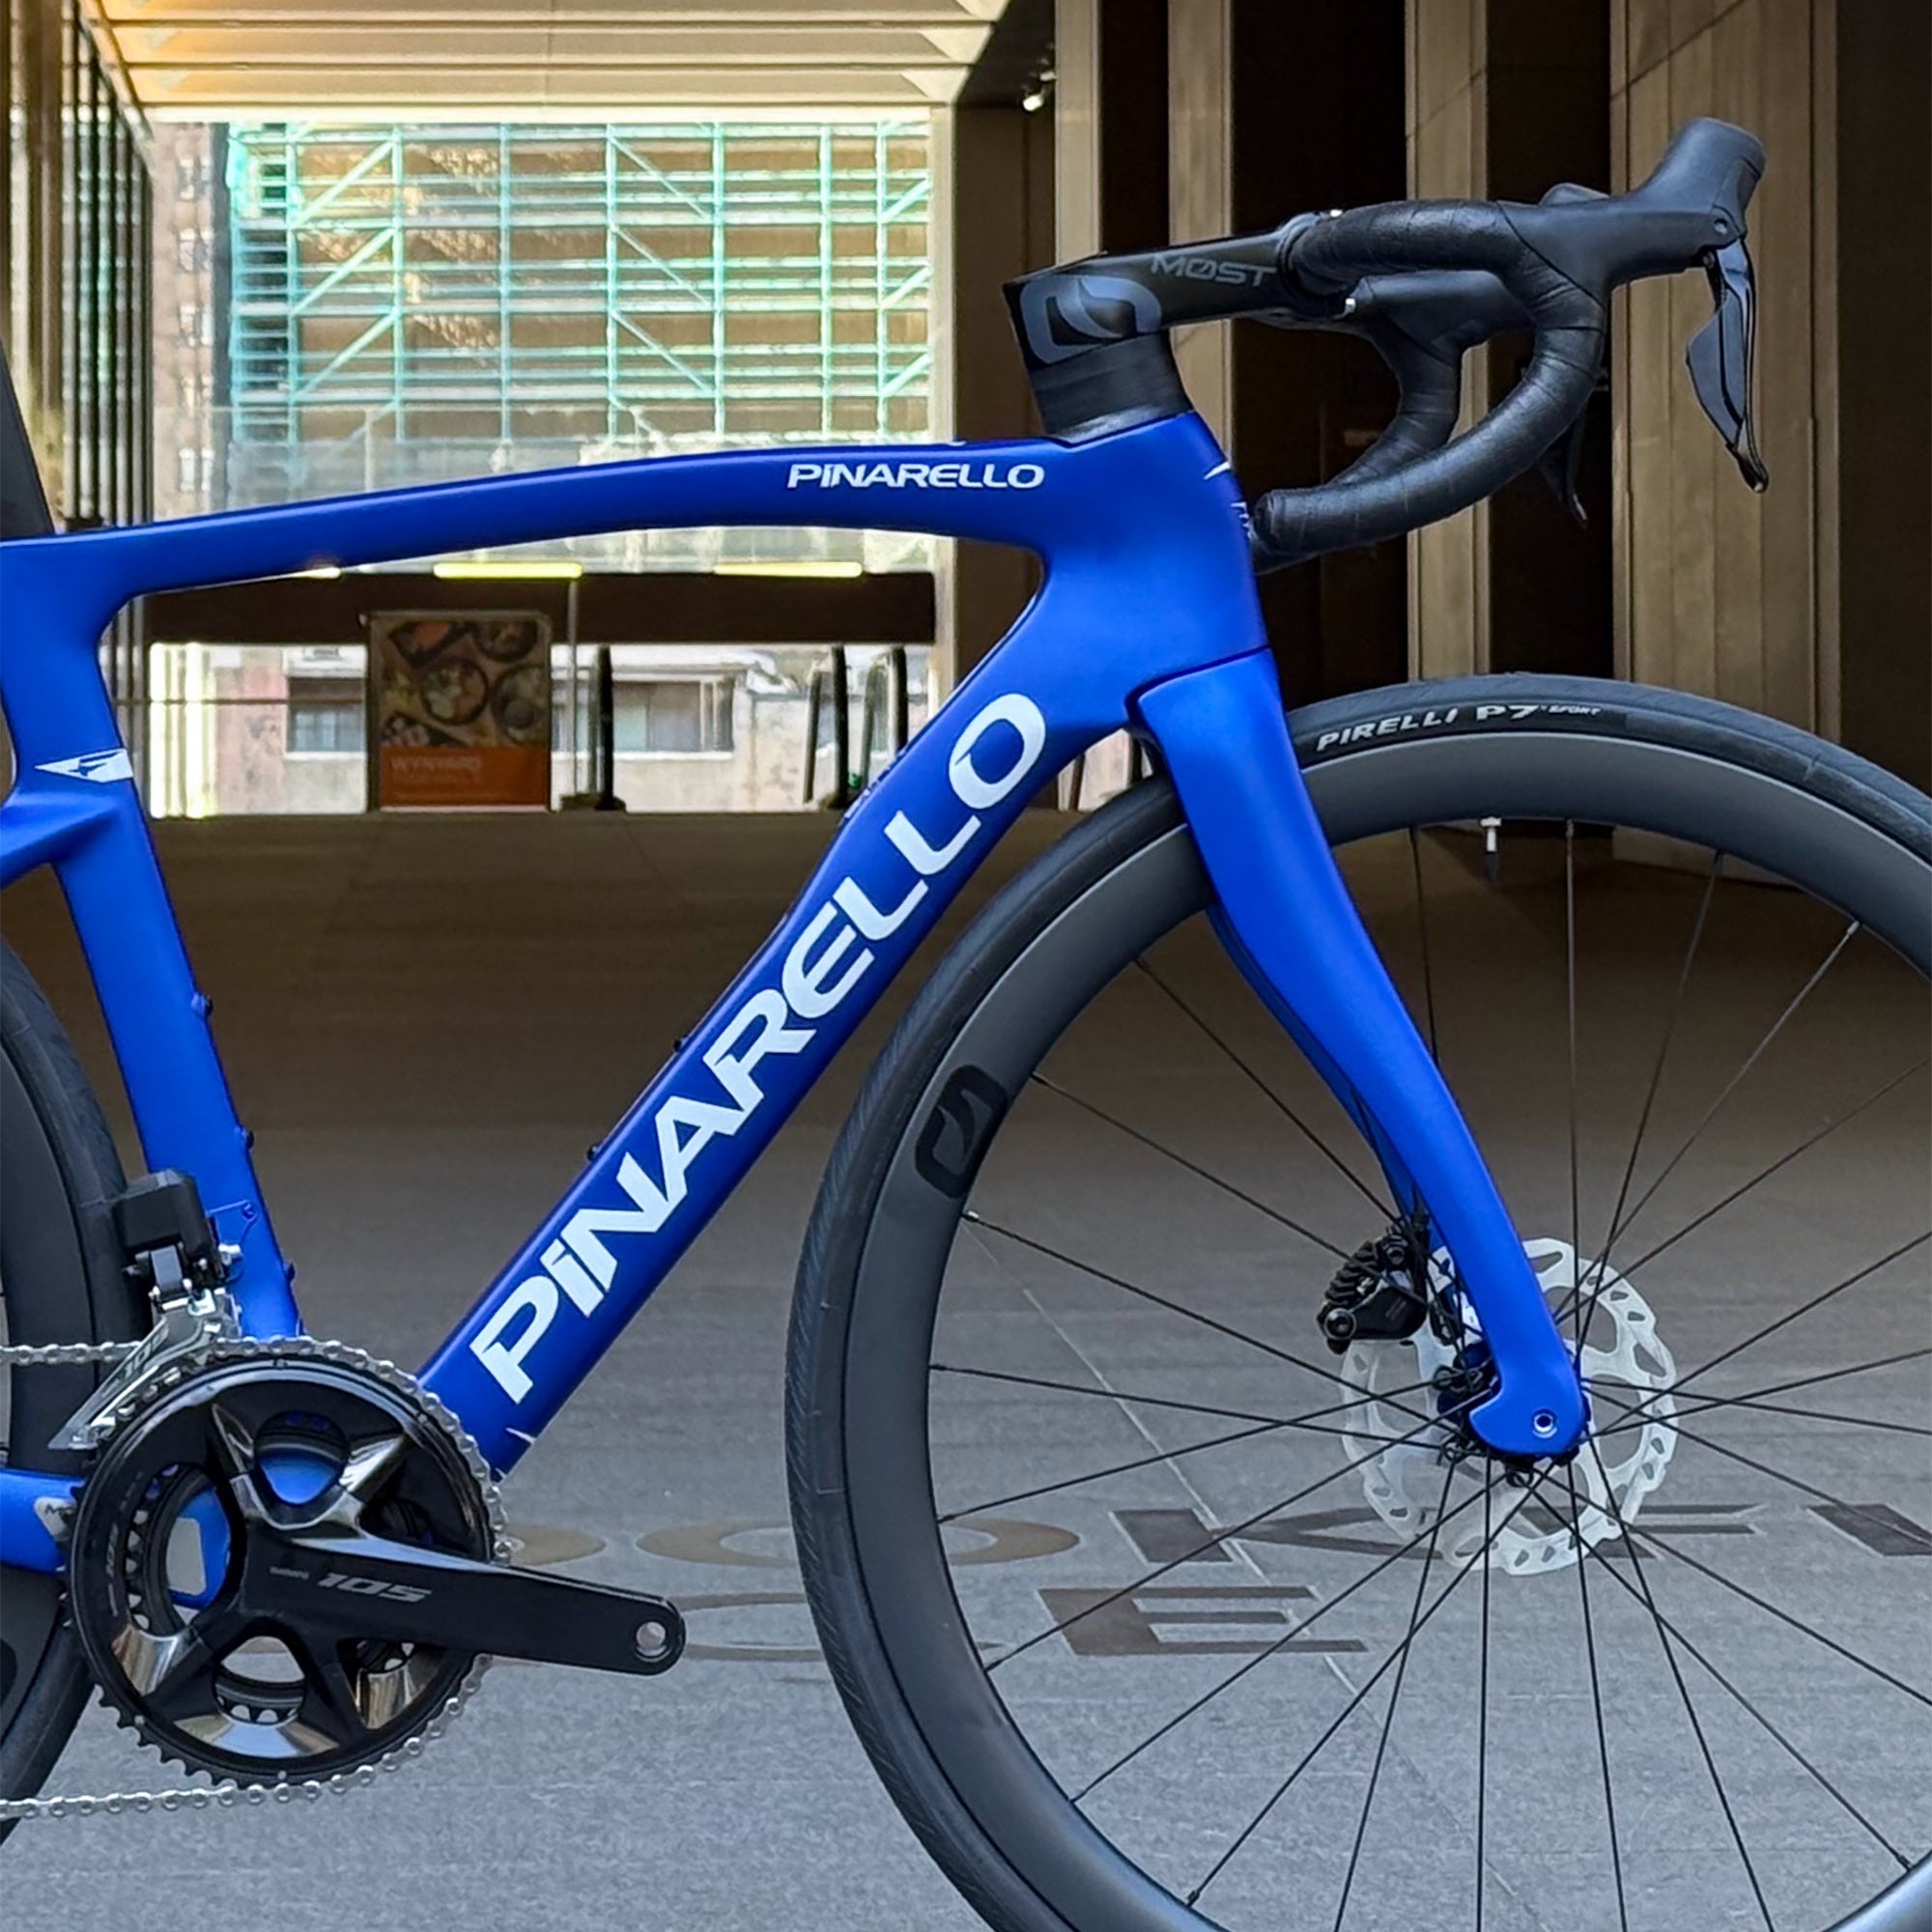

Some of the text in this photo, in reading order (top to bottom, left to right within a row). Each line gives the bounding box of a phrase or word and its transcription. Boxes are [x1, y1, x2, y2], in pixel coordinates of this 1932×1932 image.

[787, 464, 1044, 489] PINARELLO
[1316, 706, 1459, 752] PIRELLI
[1476, 704, 1540, 721] P7
[469, 692, 1046, 1405] PINARELLO
[317, 1572, 433, 1604] 105
